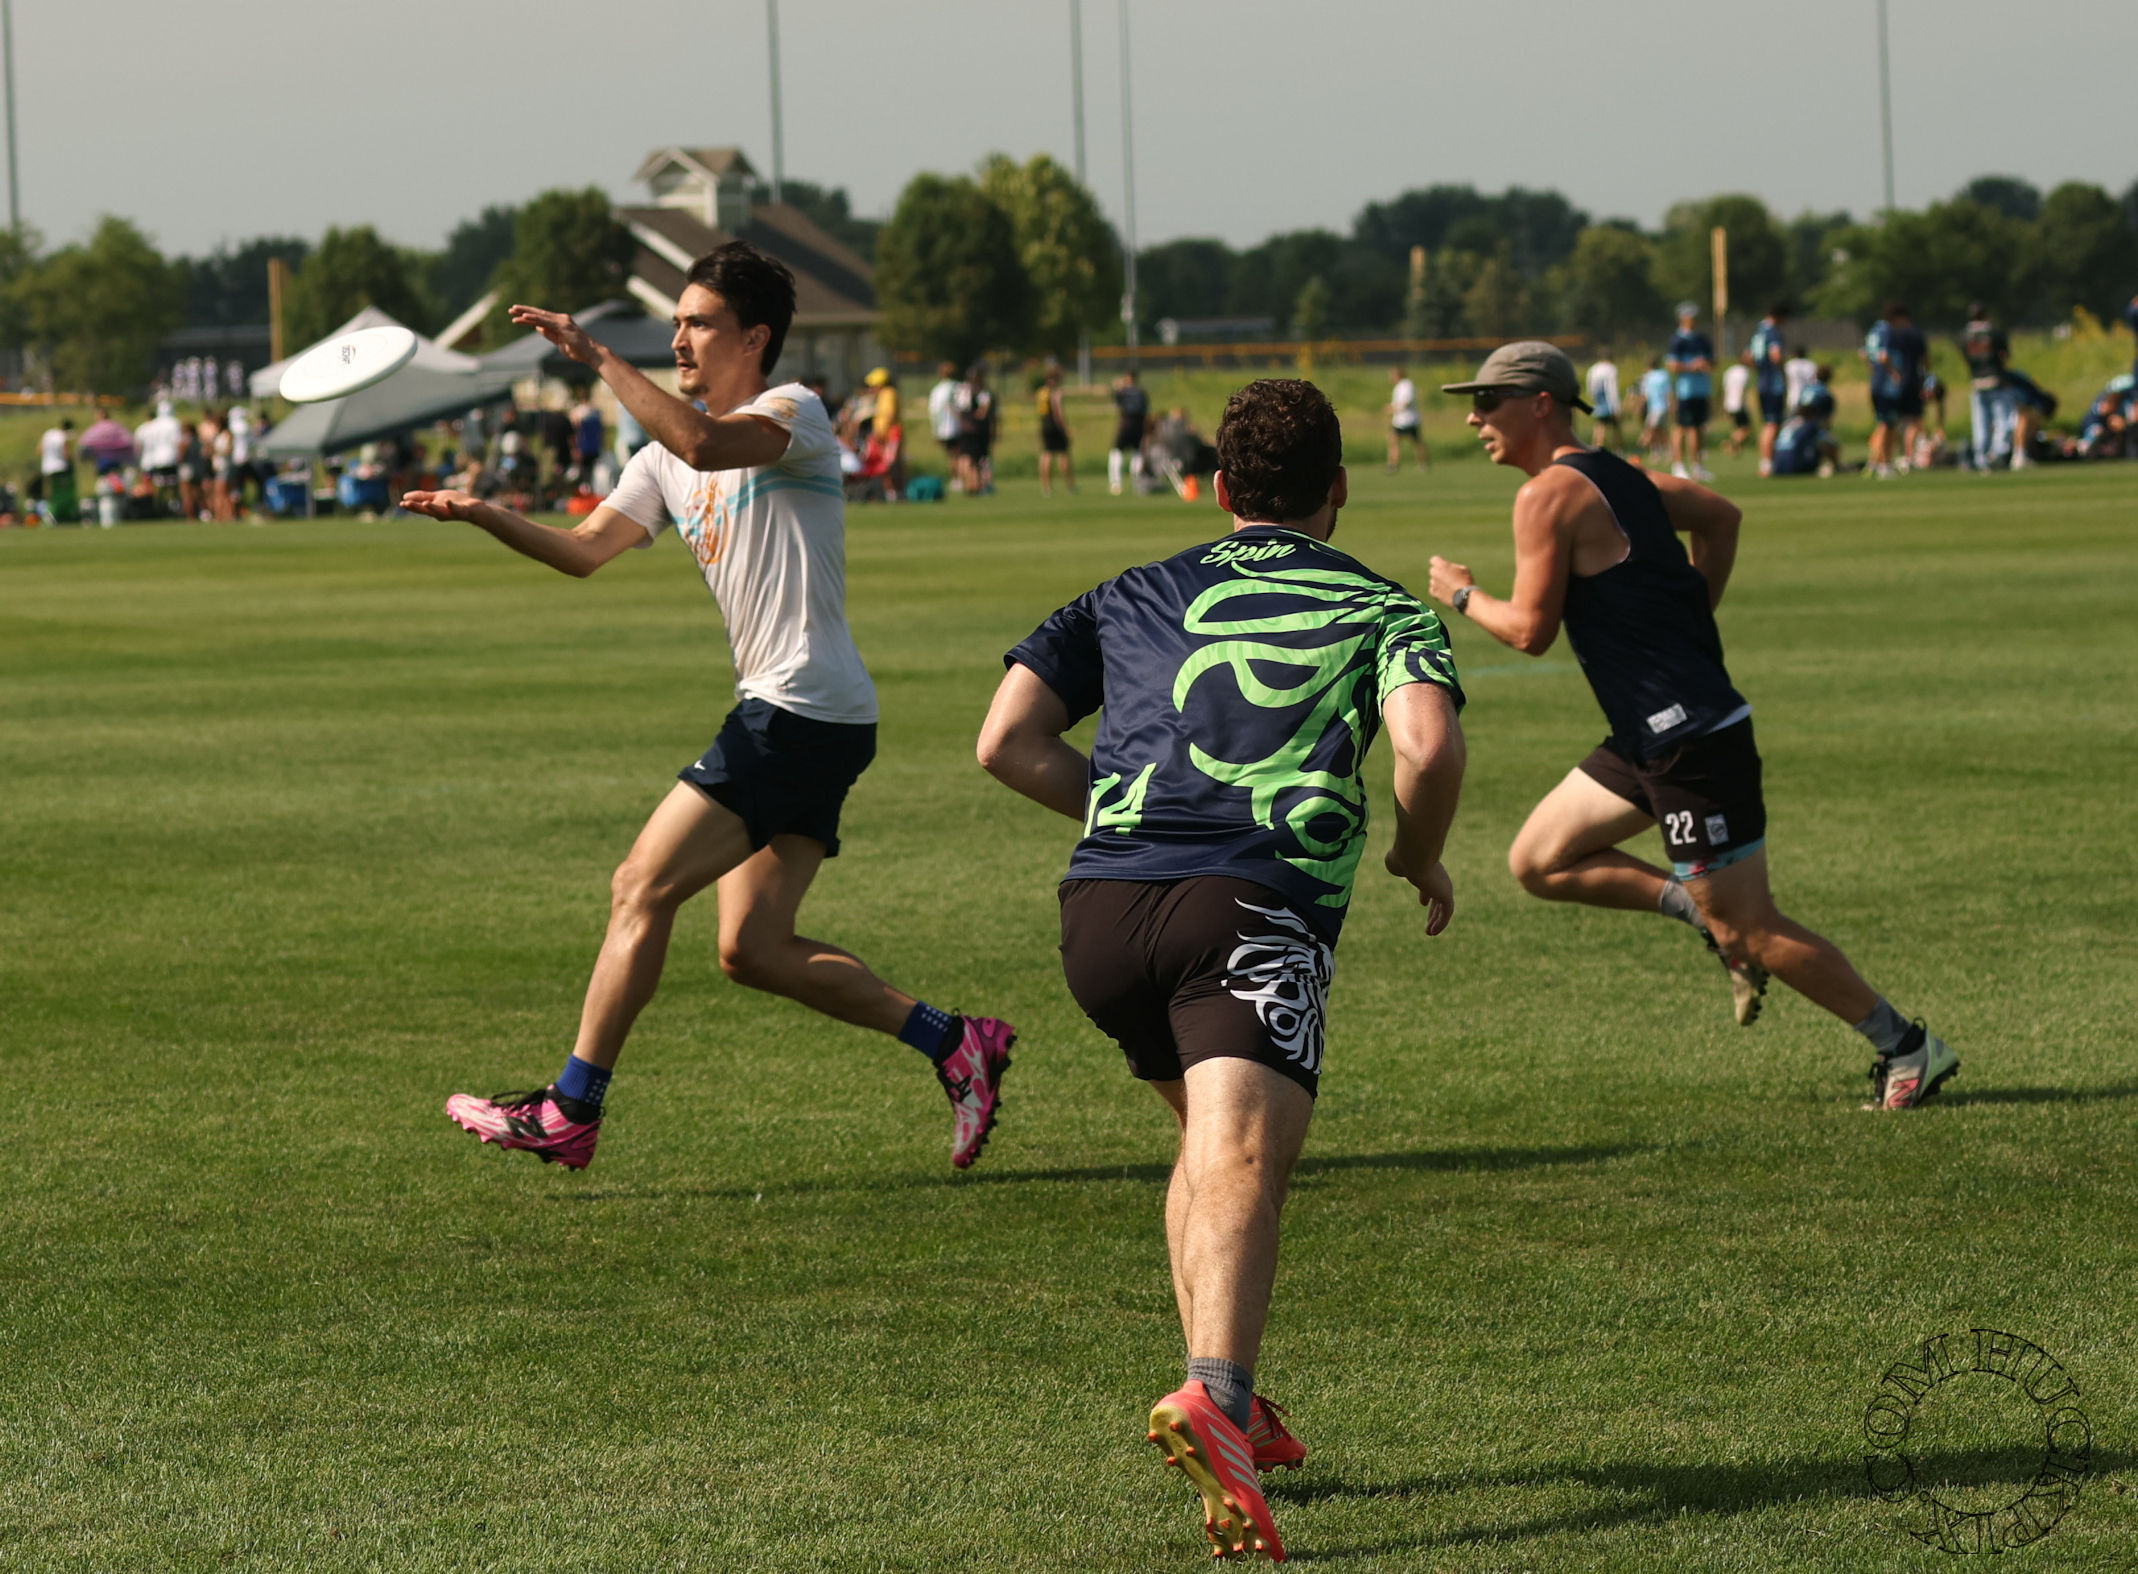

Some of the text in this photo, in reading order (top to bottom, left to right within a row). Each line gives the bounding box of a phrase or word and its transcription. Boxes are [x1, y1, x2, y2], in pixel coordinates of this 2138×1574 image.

[1200, 539, 1296, 567] Spin
[1083, 762, 1157, 837] 14
[1665, 810, 1697, 845] 22
